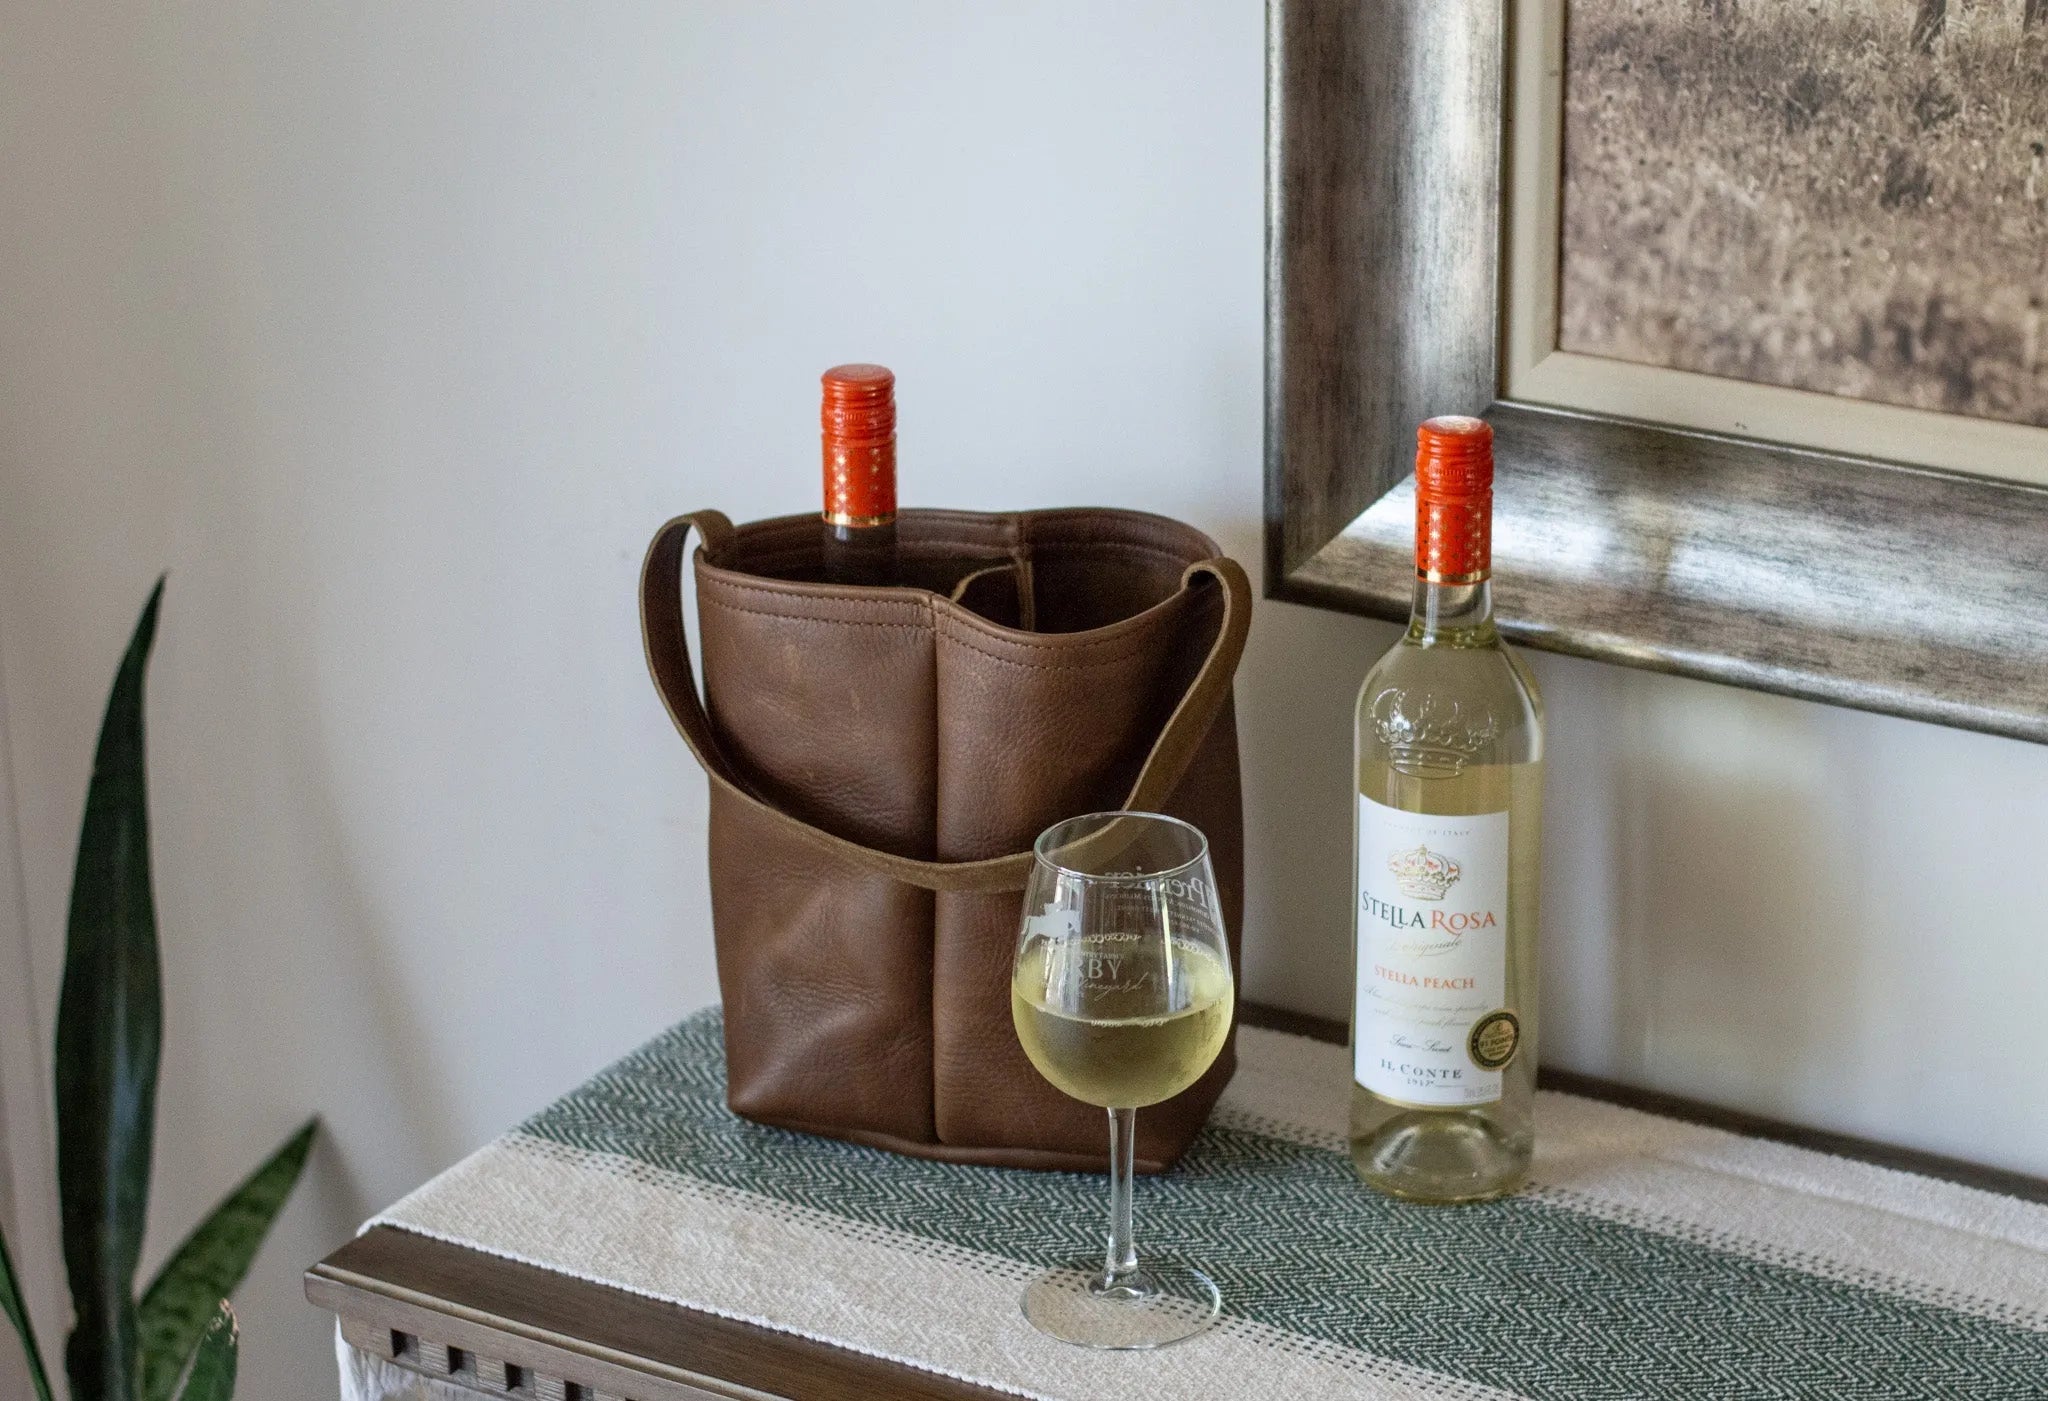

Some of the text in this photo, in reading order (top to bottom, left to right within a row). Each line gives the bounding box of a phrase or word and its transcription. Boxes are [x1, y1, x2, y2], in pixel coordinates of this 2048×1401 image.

[1361, 890, 1497, 935] STELLA ROSA
[1374, 964, 1475, 989] STELLA PEACH
[1381, 1059, 1464, 1080] IL CONTE
